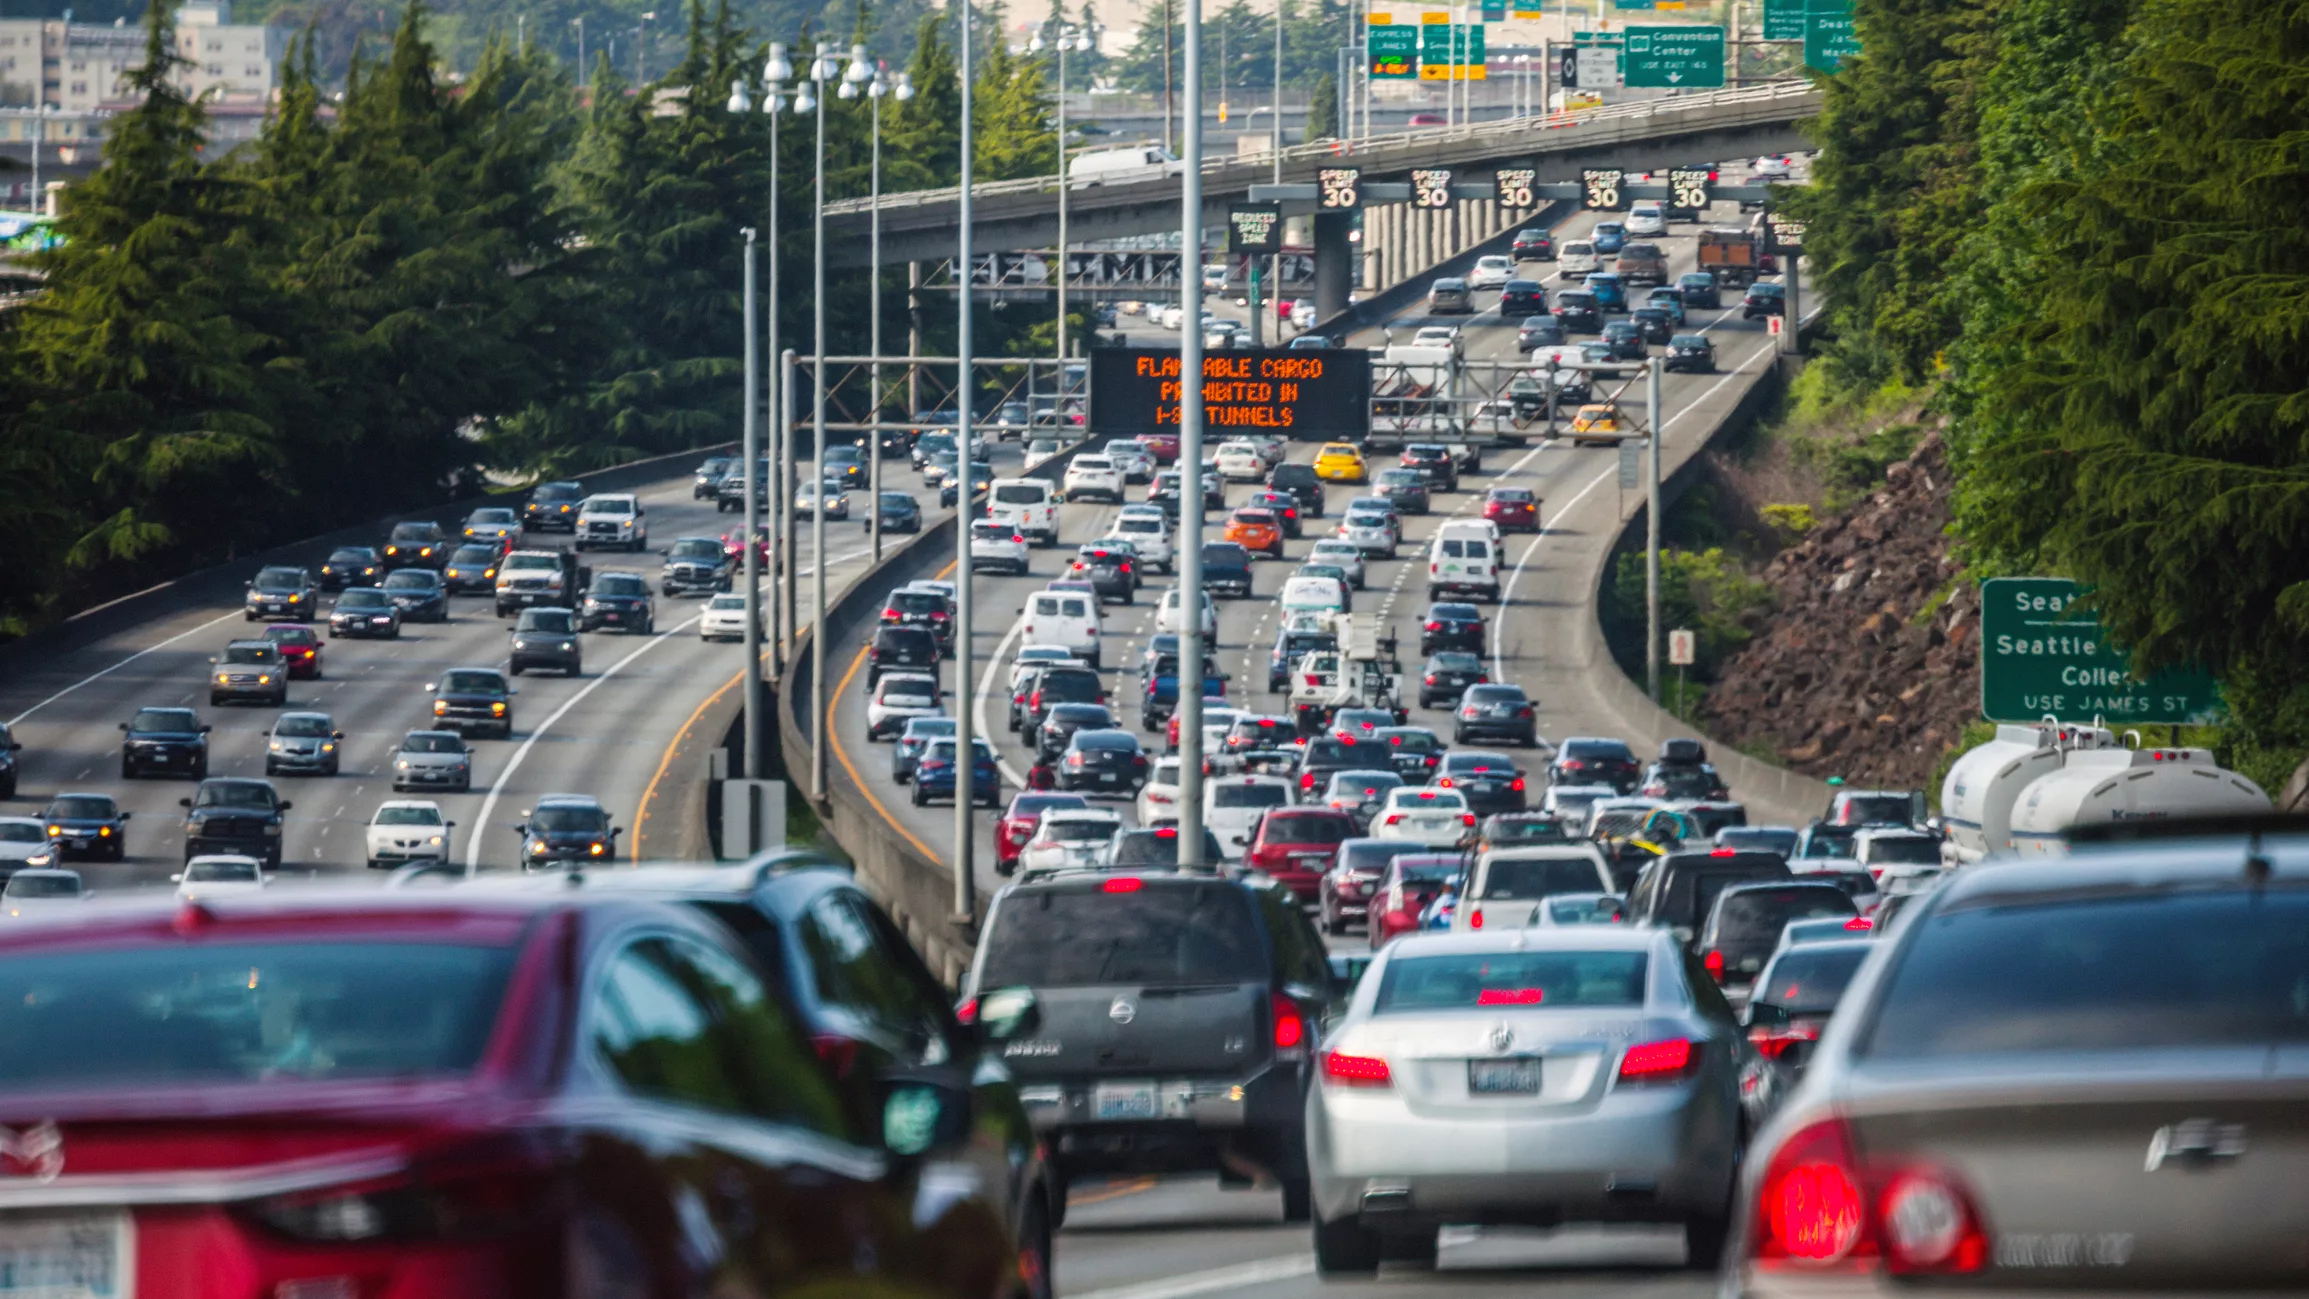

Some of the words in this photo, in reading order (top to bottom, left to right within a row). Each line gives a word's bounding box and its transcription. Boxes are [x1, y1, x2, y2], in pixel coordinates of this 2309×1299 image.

[1652, 31, 1720, 42] Convention
[1652, 46, 1696, 56] Center
[1319, 169, 1359, 181] SPEED
[1411, 169, 1451, 181] SPEED
[1496, 169, 1536, 181] SPEED
[1583, 170, 1622, 182] SPEED
[1670, 170, 1708, 182] SPEED
[1323, 180, 1354, 189] LIMIT
[1416, 180, 1448, 189] LIMIT
[1500, 180, 1531, 189] LIMIT
[1586, 181, 1618, 189] LIMIT
[1673, 181, 1705, 189] LIMIT
[1323, 188, 1357, 208] 30
[1416, 188, 1449, 208] 30
[1500, 188, 1533, 208] 30
[1587, 188, 1619, 208] 30
[1674, 188, 1707, 208] 30
[1231, 211, 1277, 224] REDUCED
[1238, 223, 1270, 234] SPEED
[1259, 358, 1323, 379] CARGO
[1279, 383, 1299, 403] IN
[1204, 406, 1293, 427] TUNNELS
[1996, 634, 2097, 656] Seattle
[2024, 695, 2065, 711] USE
[2078, 695, 2150, 713] JAMES
[2163, 696, 2189, 712] ST
